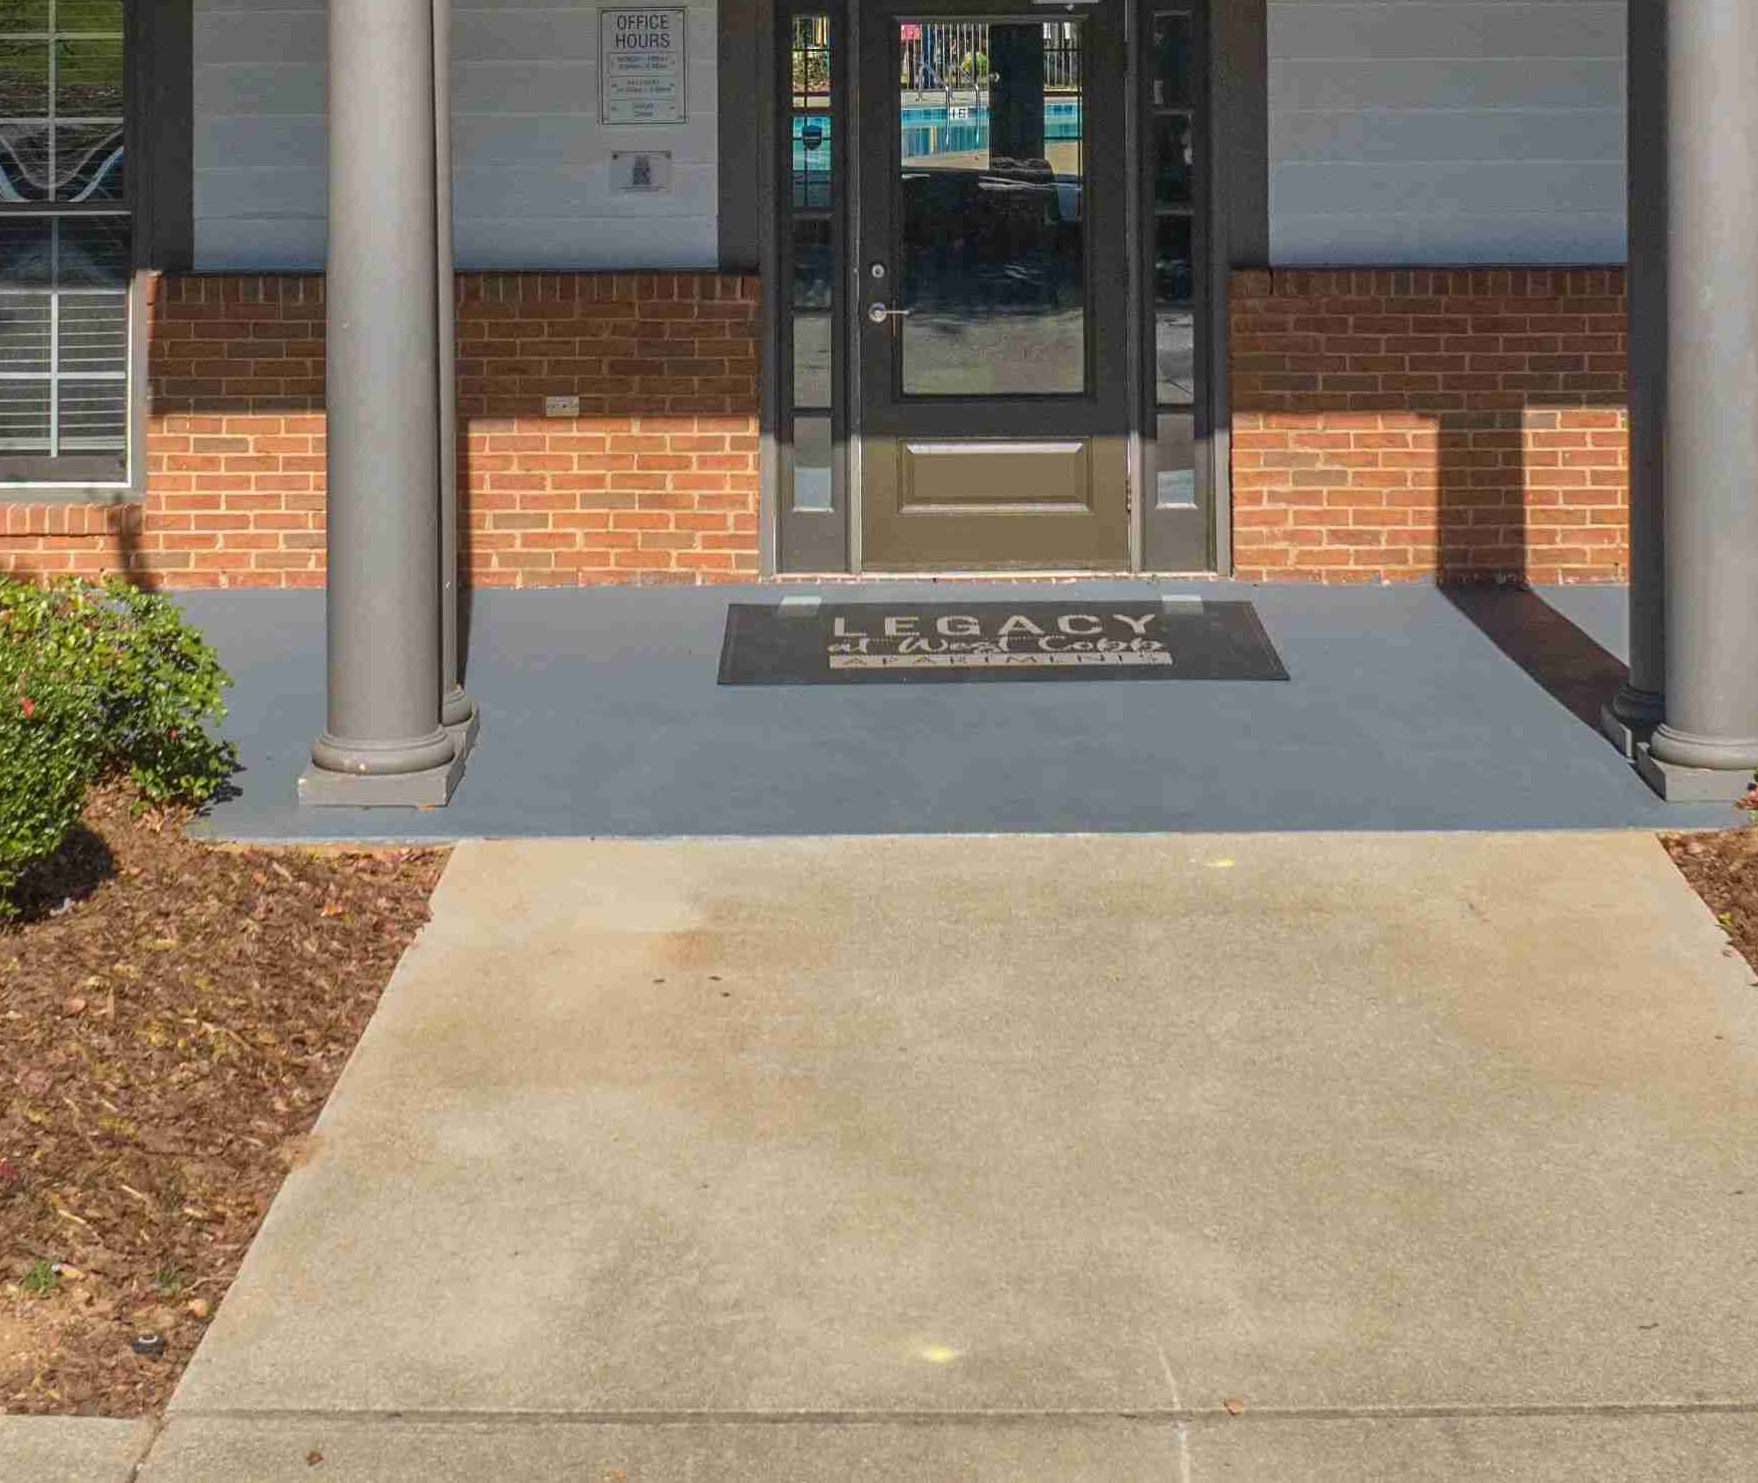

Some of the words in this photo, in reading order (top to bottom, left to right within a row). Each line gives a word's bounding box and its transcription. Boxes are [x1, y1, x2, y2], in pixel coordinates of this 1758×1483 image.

[617, 14, 668, 30] OFFICE
[615, 33, 670, 49] HOURS
[833, 613, 1157, 637] LEGACY
[1037, 635, 1167, 654] Cobb
